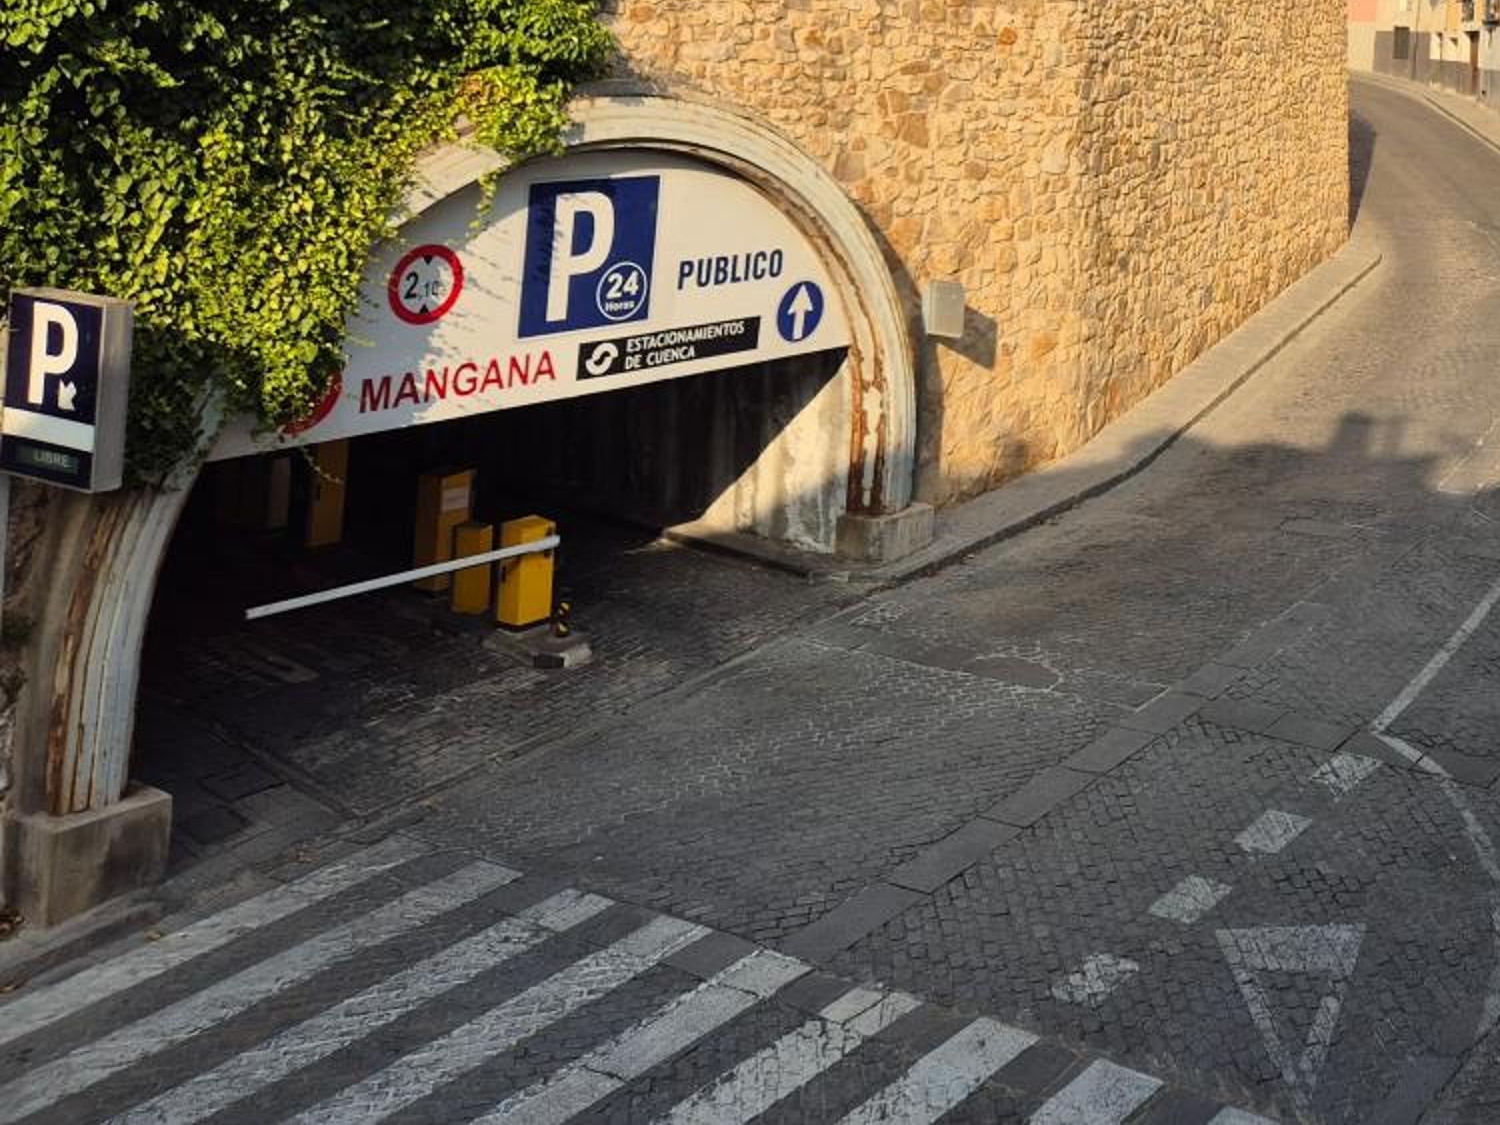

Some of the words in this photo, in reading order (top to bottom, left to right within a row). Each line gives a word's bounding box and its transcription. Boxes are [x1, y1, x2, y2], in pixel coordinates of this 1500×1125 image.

[545, 191, 615, 322] P
[677, 249, 783, 290] PUBLICO
[606, 270, 639, 300] 24
[605, 301, 635, 312] Horas
[27, 301, 78, 405] P
[626, 321, 745, 352] ESTACIONAMIENTOS
[625, 354, 642, 370] DE
[646, 345, 695, 366] CUENCA
[359, 350, 556, 413] MANGANA
